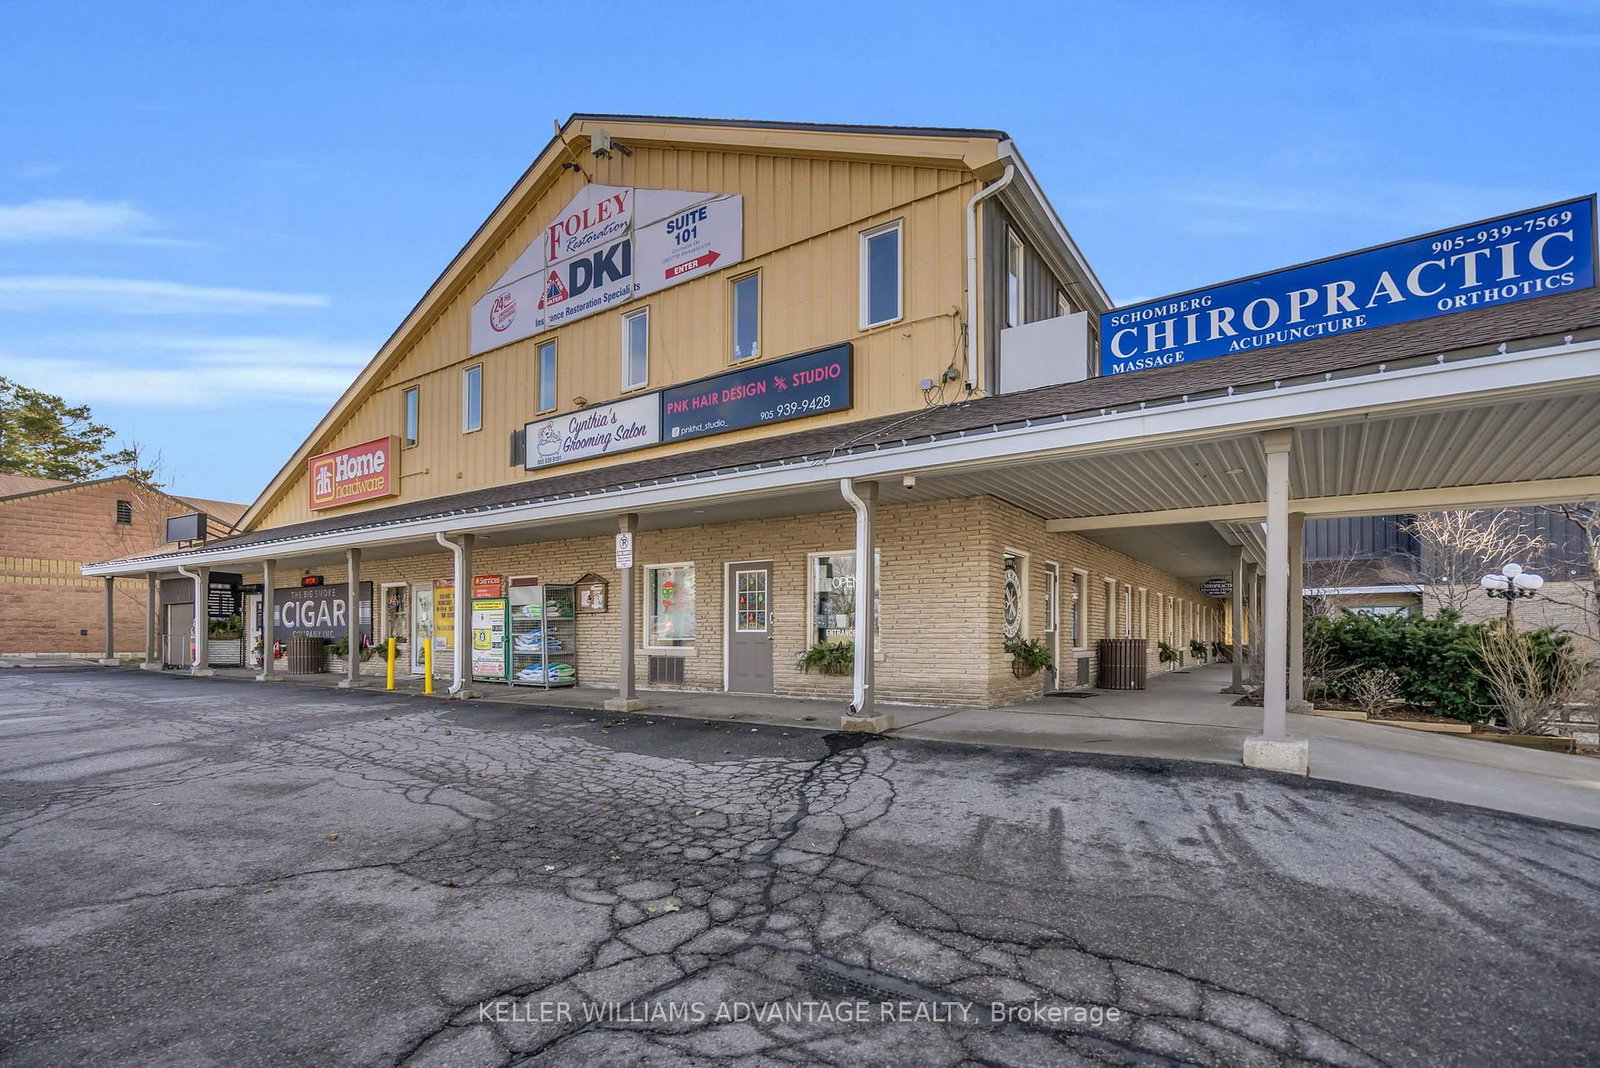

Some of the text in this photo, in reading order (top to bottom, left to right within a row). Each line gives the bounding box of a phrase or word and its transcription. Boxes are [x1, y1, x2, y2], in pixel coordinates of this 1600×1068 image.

[548, 189, 630, 262] FOLEY
[666, 205, 708, 234] SUITE
[1431, 210, 1573, 255] 905-939-7569
[566, 221, 628, 252] Restoration
[675, 225, 697, 246] 101
[568, 238, 632, 299] DKI
[674, 259, 699, 275] ENTER
[493, 295, 505, 314] 24
[535, 282, 641, 327] Insance Restoration Specialits
[1110, 229, 1575, 358] CHIROPRACTIC
[1111, 295, 1213, 327] SCHOMBERG
[1112, 272, 1575, 375] MASSAGE ACUPUNCTURE ORTHOTICS
[667, 363, 841, 414] PNK HAIR DESIGN STUDIO
[760, 394, 831, 420] 905 939-9428
[562, 422, 648, 453] Grooming Salon
[568, 407, 618, 441] Cynthia's
[335, 450, 385, 482] Home
[335, 476, 384, 499] hardware
[291, 588, 336, 599] THE BIG SMOKE
[281, 599, 347, 628] CIGAR
